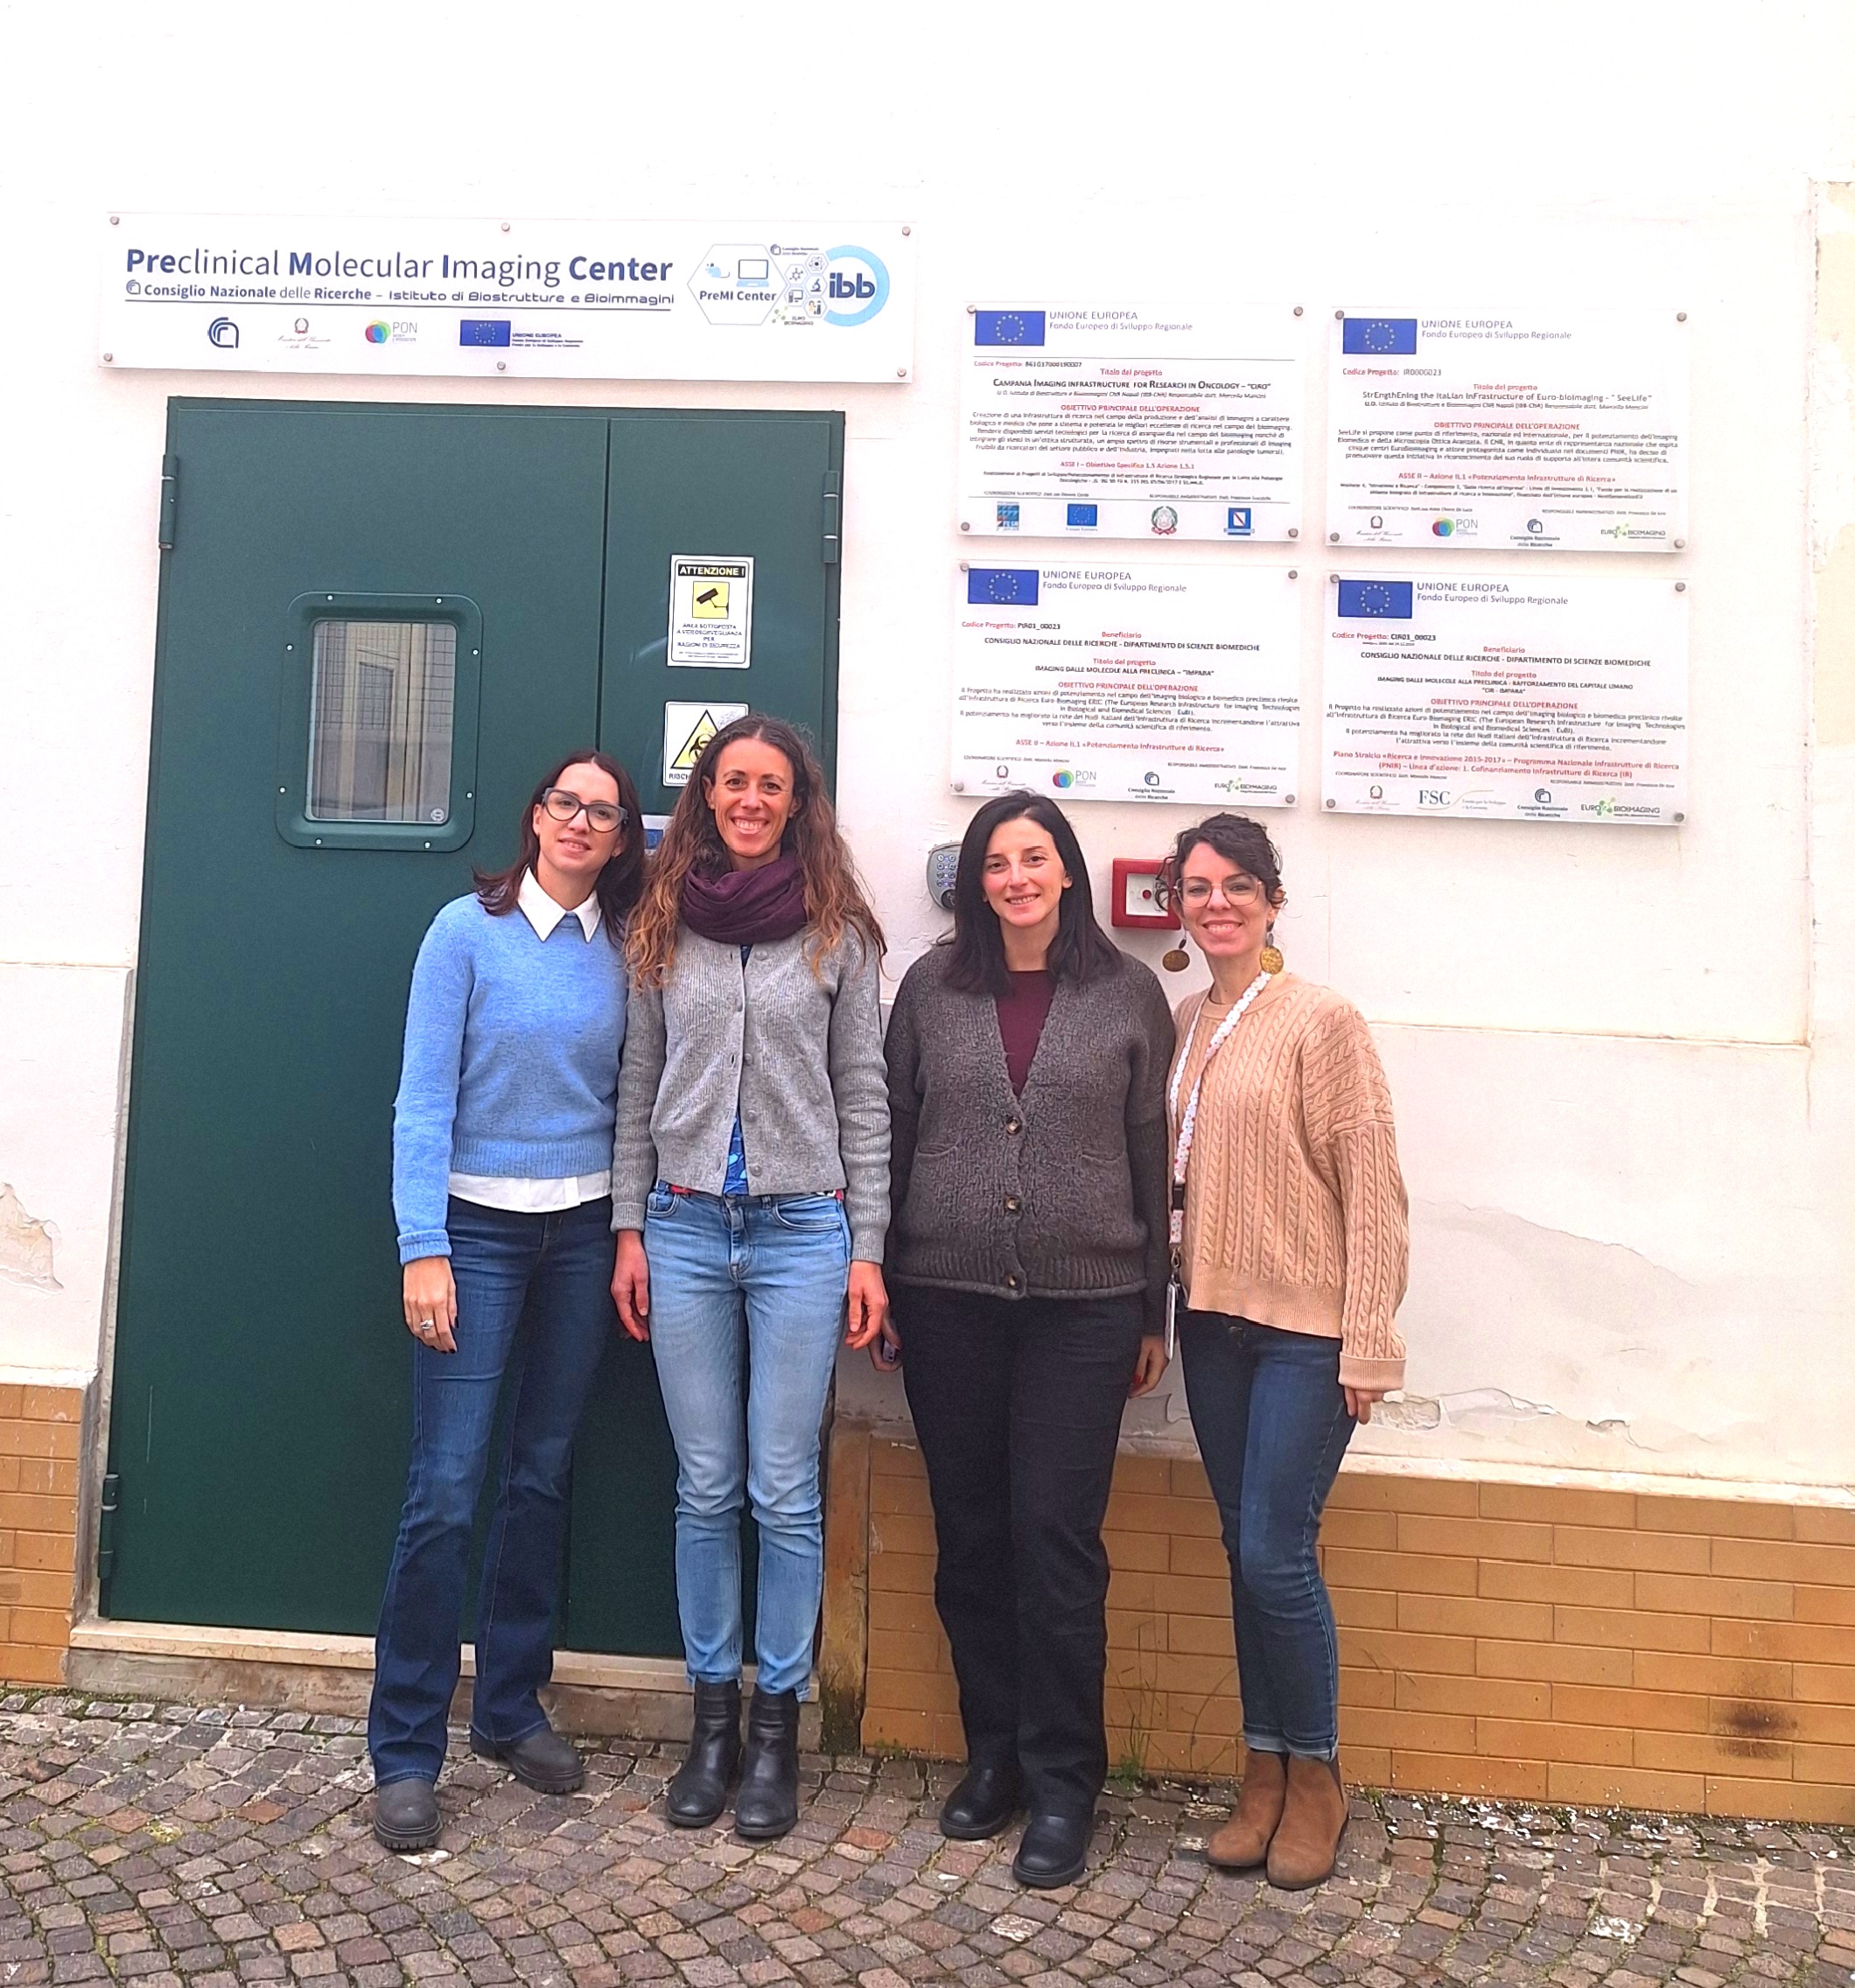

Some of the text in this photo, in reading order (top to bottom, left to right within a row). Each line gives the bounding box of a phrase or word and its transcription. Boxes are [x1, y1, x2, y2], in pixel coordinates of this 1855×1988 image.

[127, 248, 673, 288] Preclinical Molecular Imaging Center
[829, 272, 876, 299] ibb
[144, 284, 206, 299] Consiglio
[210, 285, 276, 298] Nazionale
[280, 286, 311, 298] delle
[314, 287, 372, 300] Ricerche
[388, 290, 447, 301] Istituto
[452, 291, 464, 301] di
[468, 291, 564, 303] Biostrutture
[584, 293, 675, 306] Bioimmagini
[699, 290, 777, 301] PreMI Center
[1049, 311, 1138, 320] UNIONE EUROPEA
[392, 321, 418, 334] PON
[1075, 322, 1109, 331] Europeo
[1120, 322, 1153, 332] Sviluppo
[1154, 323, 1193, 332] Regionale
[1465, 320, 1513, 329] EUROPEA
[1449, 331, 1483, 340] Europeo
[1494, 331, 1530, 340] Sviluppo
[1530, 332, 1572, 340] Regionale
[1033, 379, 1067, 388] IMAGING
[1149, 380, 1187, 388] RESEARCH
[1198, 381, 1240, 389] ONCOLOGY
[1455, 519, 1479, 529] PON
[679, 565, 739, 576] ATTENZIONE
[1043, 570, 1131, 580] UNIONE EUROPEA
[1068, 582, 1102, 592] Europeo
[1113, 583, 1147, 592] Sviluppo
[1148, 584, 1186, 593] Regionale
[1417, 582, 1509, 592] UNIONE EUROPEA
[1444, 594, 1479, 604] Europeo
[1490, 595, 1525, 606] Sviluppo
[1527, 596, 1568, 606] Regionale
[1514, 758, 1557, 766] Programma
[1594, 760, 1643, 769] Infrastrutture
[1075, 770, 1097, 780] PON
[1471, 766, 1531, 774] Cofinanziamento
[1532, 767, 1582, 776] Infrastrutture
[1419, 790, 1451, 805] FSC
[1580, 803, 1602, 812] EURO
